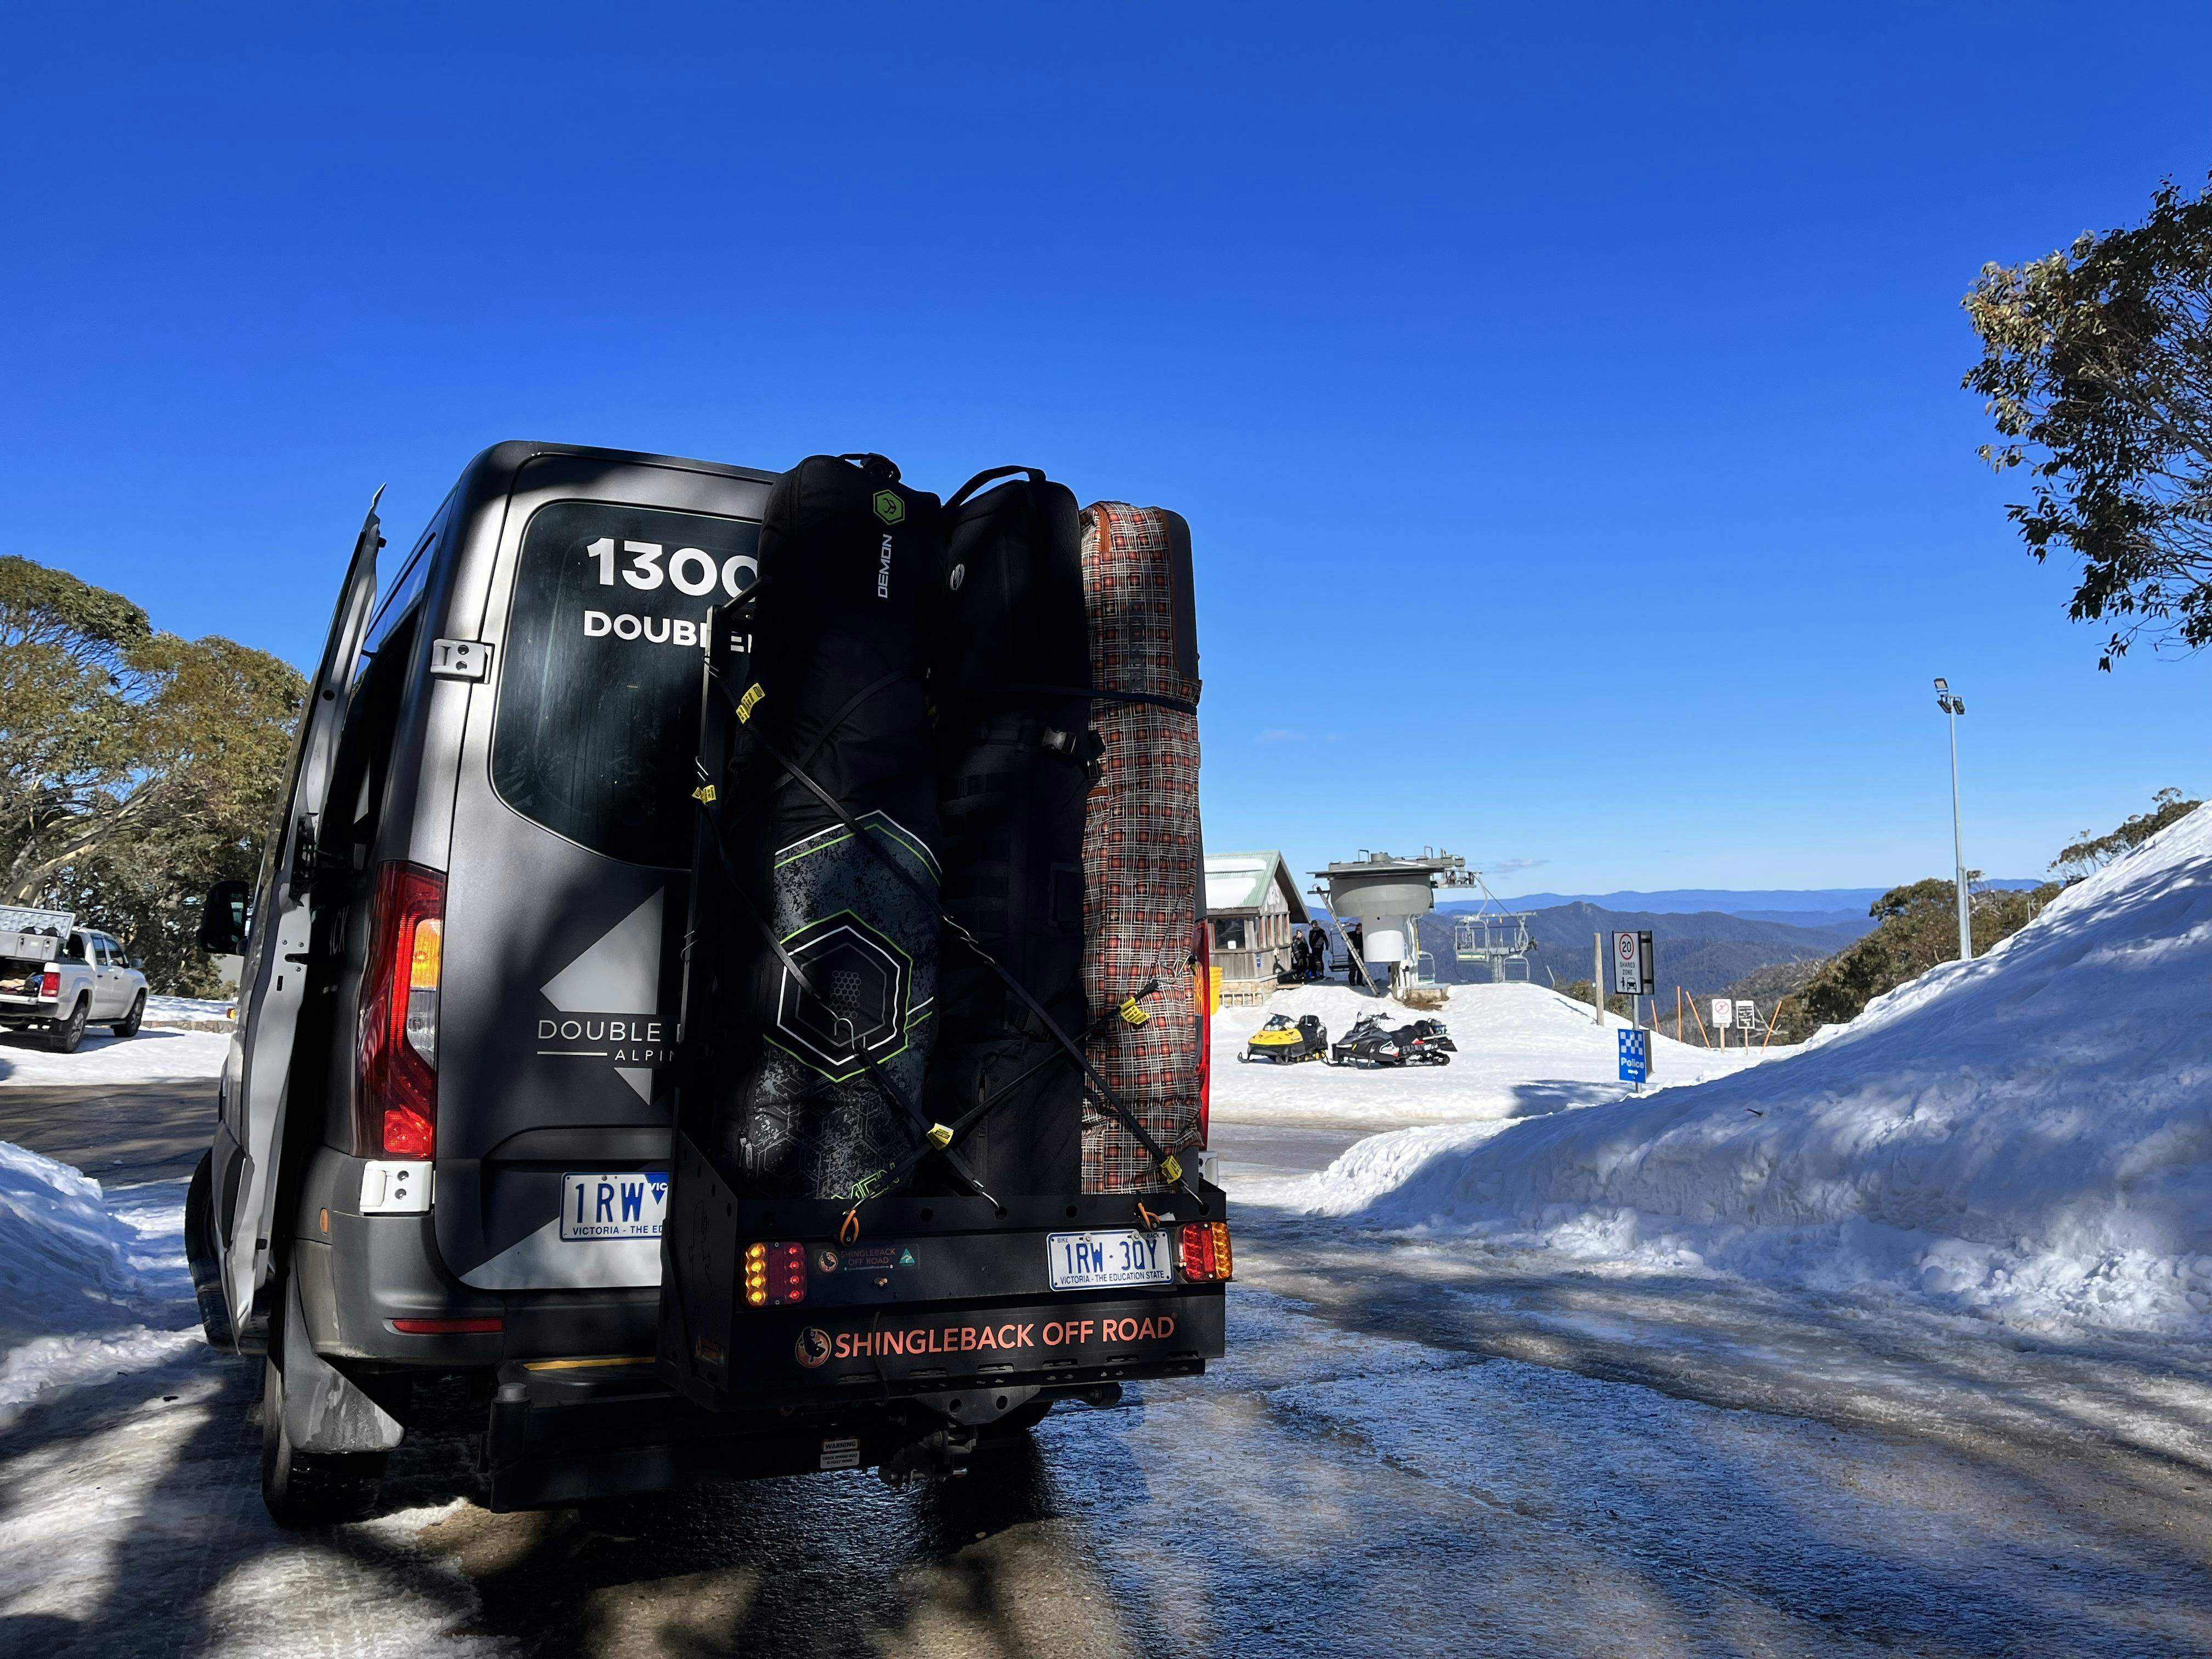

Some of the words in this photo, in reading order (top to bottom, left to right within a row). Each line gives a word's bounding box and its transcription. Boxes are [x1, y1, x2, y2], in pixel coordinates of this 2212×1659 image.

[587, 537, 758, 602] 1300
[878, 534, 892, 598] DEMON
[1622, 941, 1632, 953] 20
[538, 1020, 662, 1042] DOUBLE
[1621, 1057, 1644, 1069] Police
[648, 1182, 668, 1191] VIC
[575, 1182, 644, 1223] 1RW
[573, 1226, 619, 1235] VICTORIA
[629, 1225, 648, 1234] THE
[840, 1248, 896, 1259] SHINGLEBACK
[866, 1257, 889, 1265] ROAD
[1060, 1275, 1090, 1285] VICTORIA
[1095, 1274, 1107, 1282] THE
[1109, 1272, 1145, 1281] EDUCATION
[1146, 1271, 1165, 1279] STATE
[834, 1323, 1034, 1358] SHINGLEBACK
[1042, 1320, 1094, 1347] OFF
